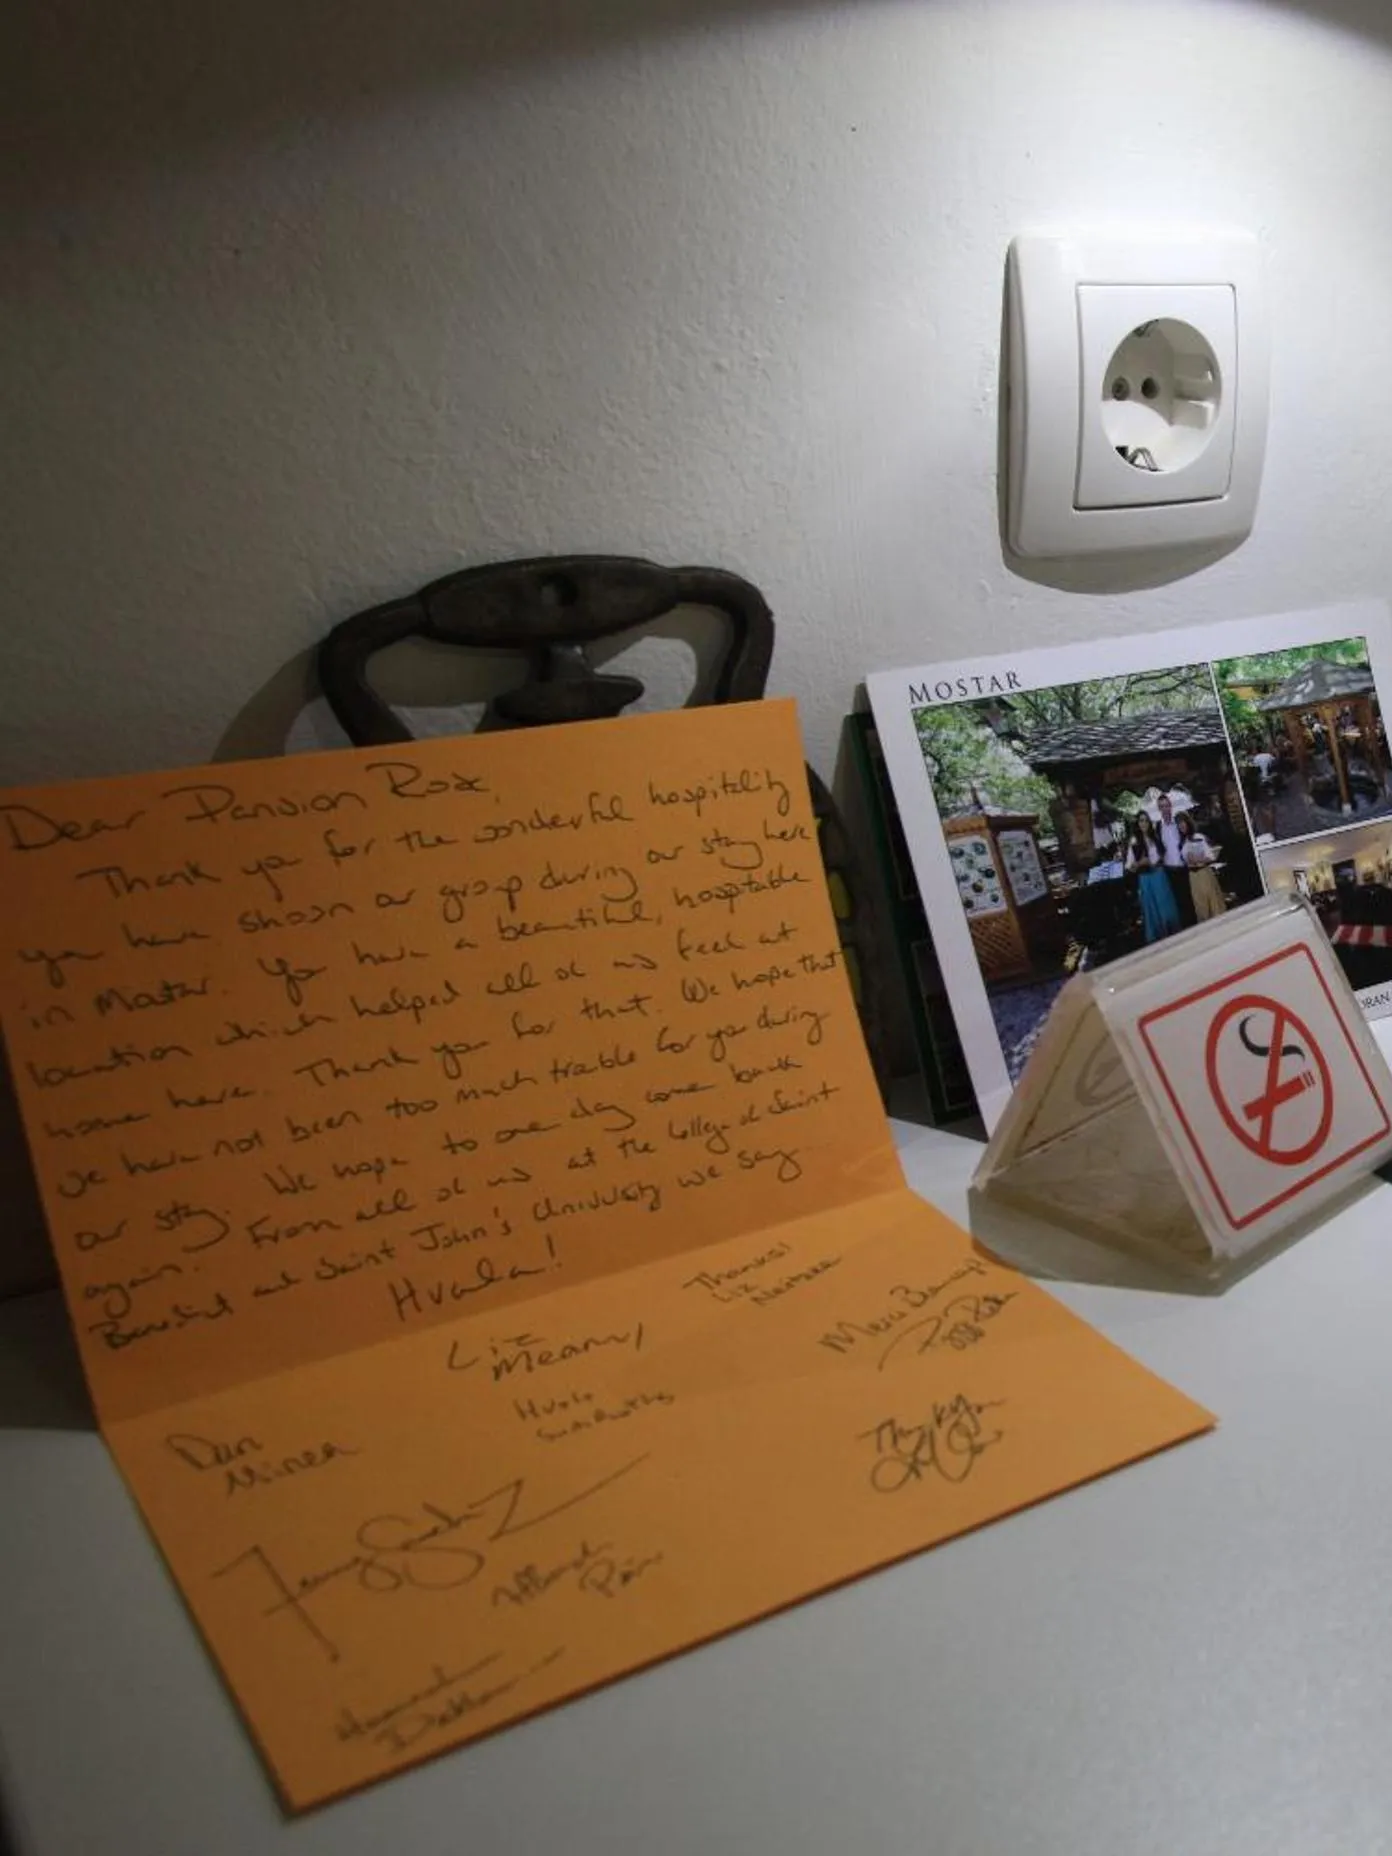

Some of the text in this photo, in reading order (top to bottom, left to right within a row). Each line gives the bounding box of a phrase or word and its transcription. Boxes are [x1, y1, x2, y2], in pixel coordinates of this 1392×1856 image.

[907, 671, 1023, 704] MOSTAR
[0, 804, 146, 851] Dear
[75, 769, 790, 902] Thank you for the wonderful hospitality
[17, 949, 106, 990] you
[121, 922, 211, 949] have
[238, 902, 354, 935] shown
[439, 872, 524, 924] group
[540, 862, 639, 901] during
[701, 827, 764, 870] stay
[763, 818, 815, 842] here
[26, 1044, 194, 1088] location
[215, 1011, 338, 1047] which
[351, 978, 461, 1025] helped
[486, 965, 541, 996] all
[676, 929, 745, 962] feel
[758, 923, 799, 950] at
[31, 1004, 76, 1030] in
[258, 956, 328, 1007] You
[352, 941, 430, 966] have
[455, 938, 479, 951] a
[43, 1111, 152, 1141] home
[294, 1046, 420, 1087] Thank
[430, 1040, 489, 1081] you
[511, 1011, 556, 1038] for
[681, 972, 721, 1003] We
[732, 960, 797, 990] hope
[798, 949, 844, 976] that
[121, 1151, 201, 1177] have
[213, 1128, 264, 1157] not
[286, 1109, 363, 1144] been
[386, 1097, 438, 1120] too
[456, 1071, 539, 1104] much
[549, 1049, 638, 1090] trouble
[656, 1026, 697, 1055] for
[706, 1022, 748, 1064] you
[757, 1005, 832, 1047] during
[264, 1163, 317, 1196] We
[333, 1156, 410, 1186] hope
[442, 1130, 479, 1155] to
[495, 1119, 563, 1145] one
[570, 1099, 637, 1133] day
[645, 1081, 717, 1106] come
[729, 1053, 803, 1085] back
[246, 1215, 343, 1250] From
[355, 1188, 418, 1222] all
[568, 1147, 597, 1171] at
[618, 1137, 656, 1159] the
[767, 1081, 842, 1116] Saint
[314, 1239, 397, 1282] Saint
[410, 1205, 514, 1254] John's
[532, 1181, 664, 1222] University
[678, 1164, 723, 1189] we
[738, 1146, 804, 1185] say
